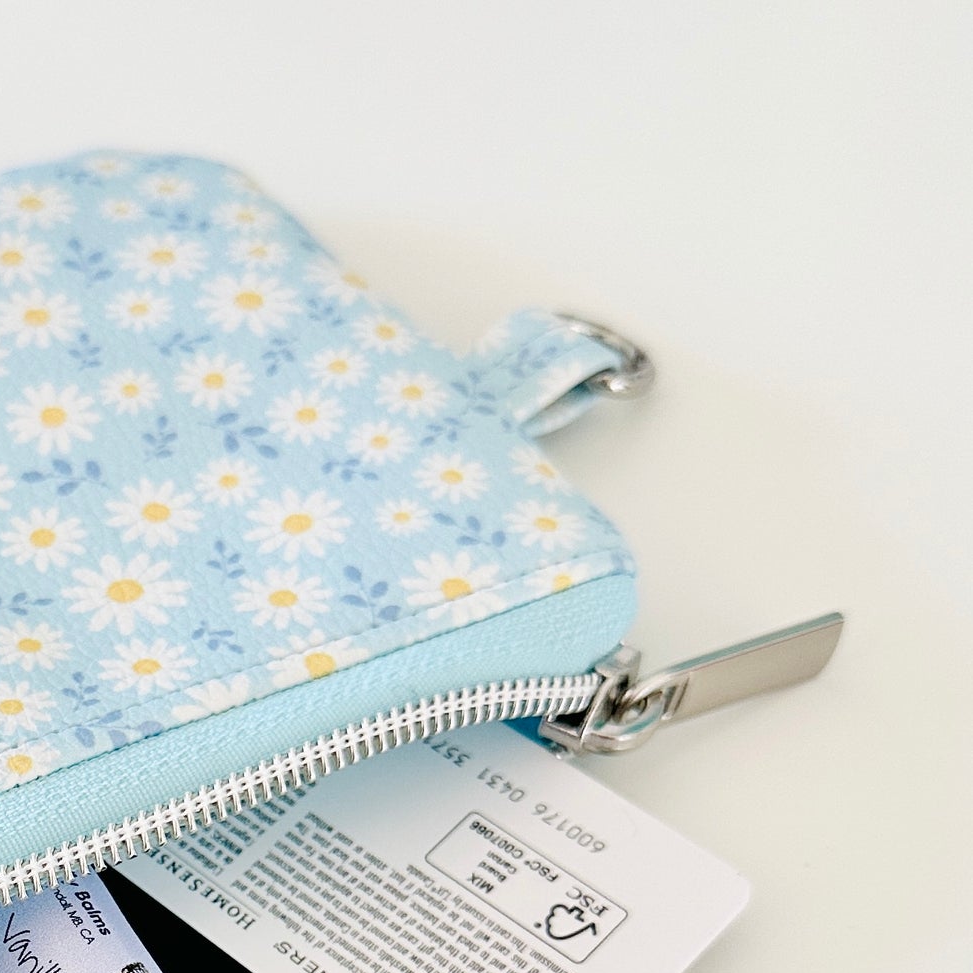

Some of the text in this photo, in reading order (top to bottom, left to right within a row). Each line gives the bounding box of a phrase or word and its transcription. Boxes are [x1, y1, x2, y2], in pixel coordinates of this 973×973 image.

[475, 765, 526, 804] 0431
[528, 800, 607, 857] 600176
[476, 859, 508, 883] Board
[484, 849, 518, 875] Carton
[403, 880, 415, 891] if
[465, 871, 495, 895] MIX
[411, 885, 449, 914] replaced
[448, 893, 464, 907] by
[564, 884, 609, 918] FSC
[75, 890, 111, 937] Balms
[395, 908, 409, 920] an
[403, 915, 418, 928] of
[444, 909, 460, 922] be
[459, 902, 487, 924] issued
[355, 916, 370, 930] be
[387, 920, 402, 933] are
[435, 920, 457, 939] card
[456, 917, 476, 934] not
[482, 918, 495, 930] is
[80, 928, 96, 945] CA
[346, 928, 360, 940] in
[365, 923, 395, 948] cannot
[397, 929, 419, 947] card
[413, 922, 447, 949] balance
[472, 928, 491, 945] will
[489, 923, 512, 942] card
[355, 934, 380, 954] store
[389, 941, 409, 958] and
[415, 939, 436, 957] gift
[441, 942, 460, 958] the
[454, 933, 481, 955] check
[488, 939, 511, 958] card
[507, 935, 528, 953] This
[429, 951, 450, 968] this
[456, 952, 470, 965] to
[476, 949, 490, 962] to
[487, 956, 507, 973] and
[507, 953, 528, 971] this
[366, 960, 382, 973] be
